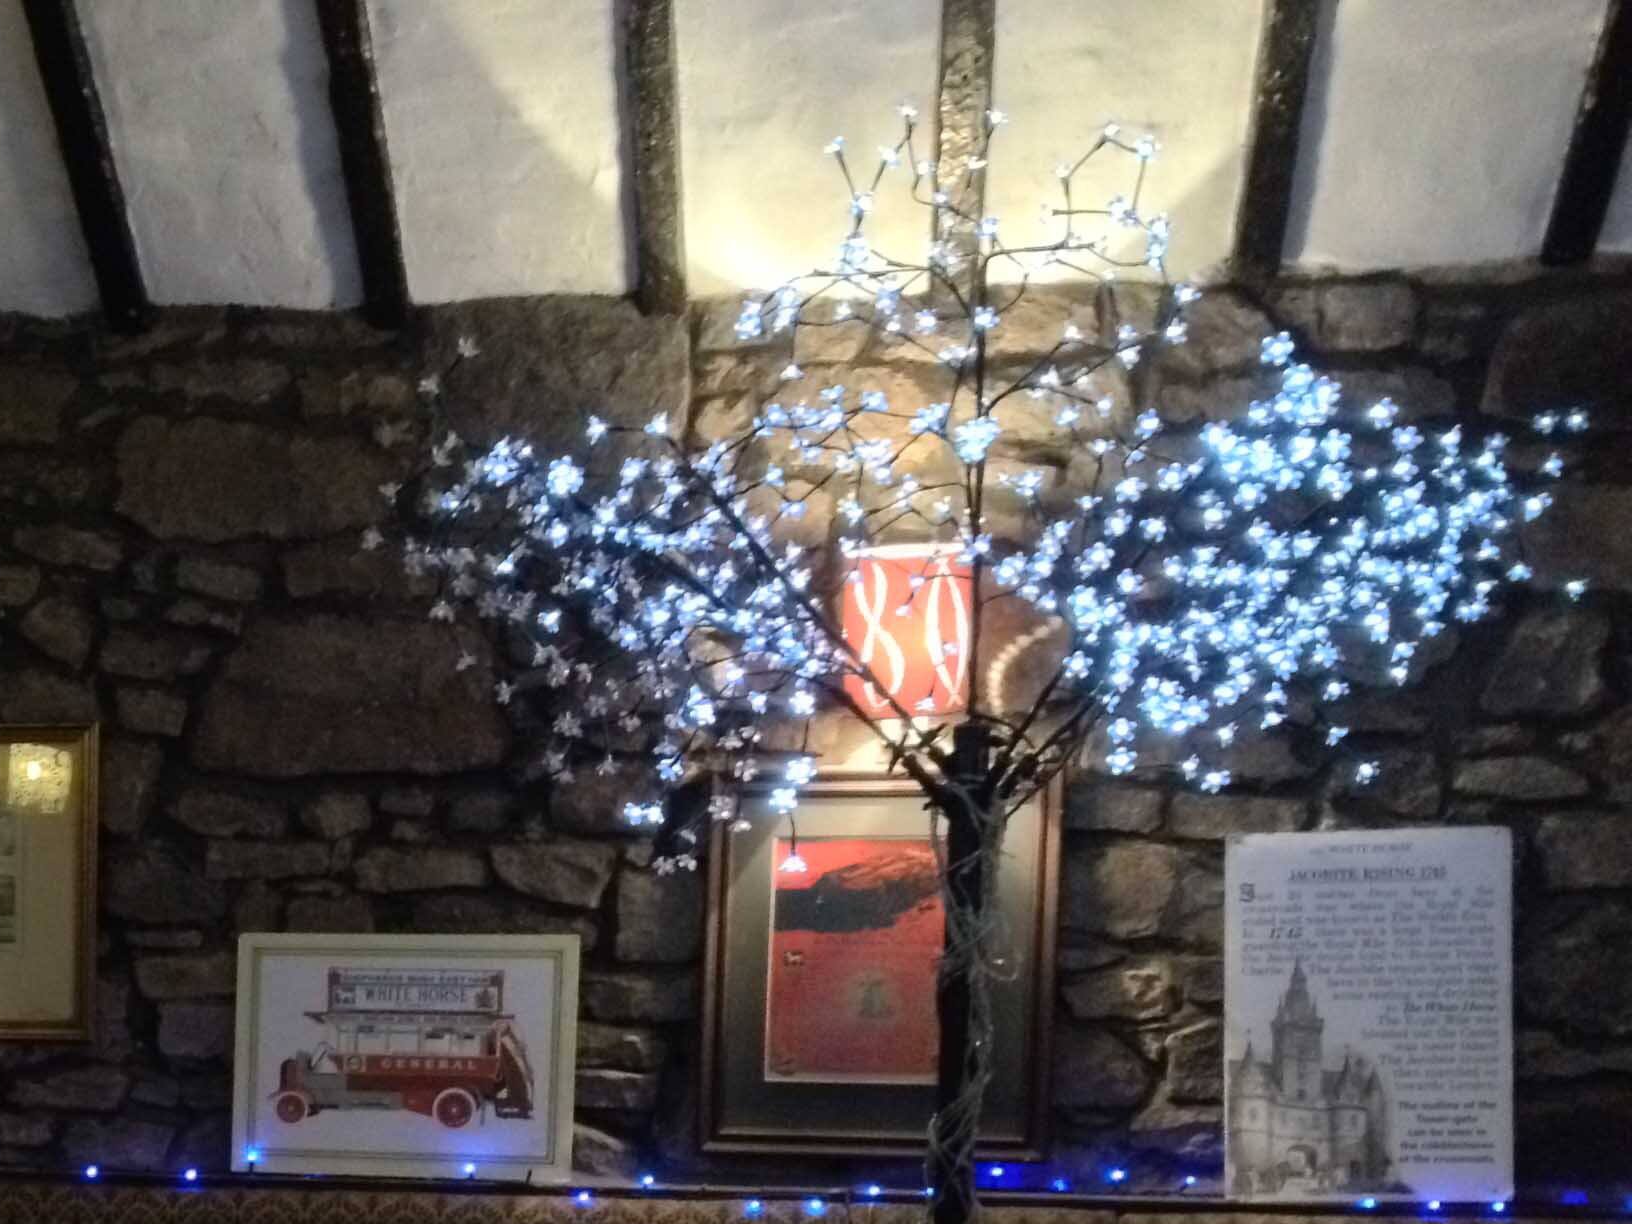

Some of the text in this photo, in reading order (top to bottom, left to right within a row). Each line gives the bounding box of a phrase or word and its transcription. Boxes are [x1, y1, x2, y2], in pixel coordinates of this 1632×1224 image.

[364, 985, 468, 1004] WHITE HORSE
[379, 1058, 478, 1072] GENERAL
